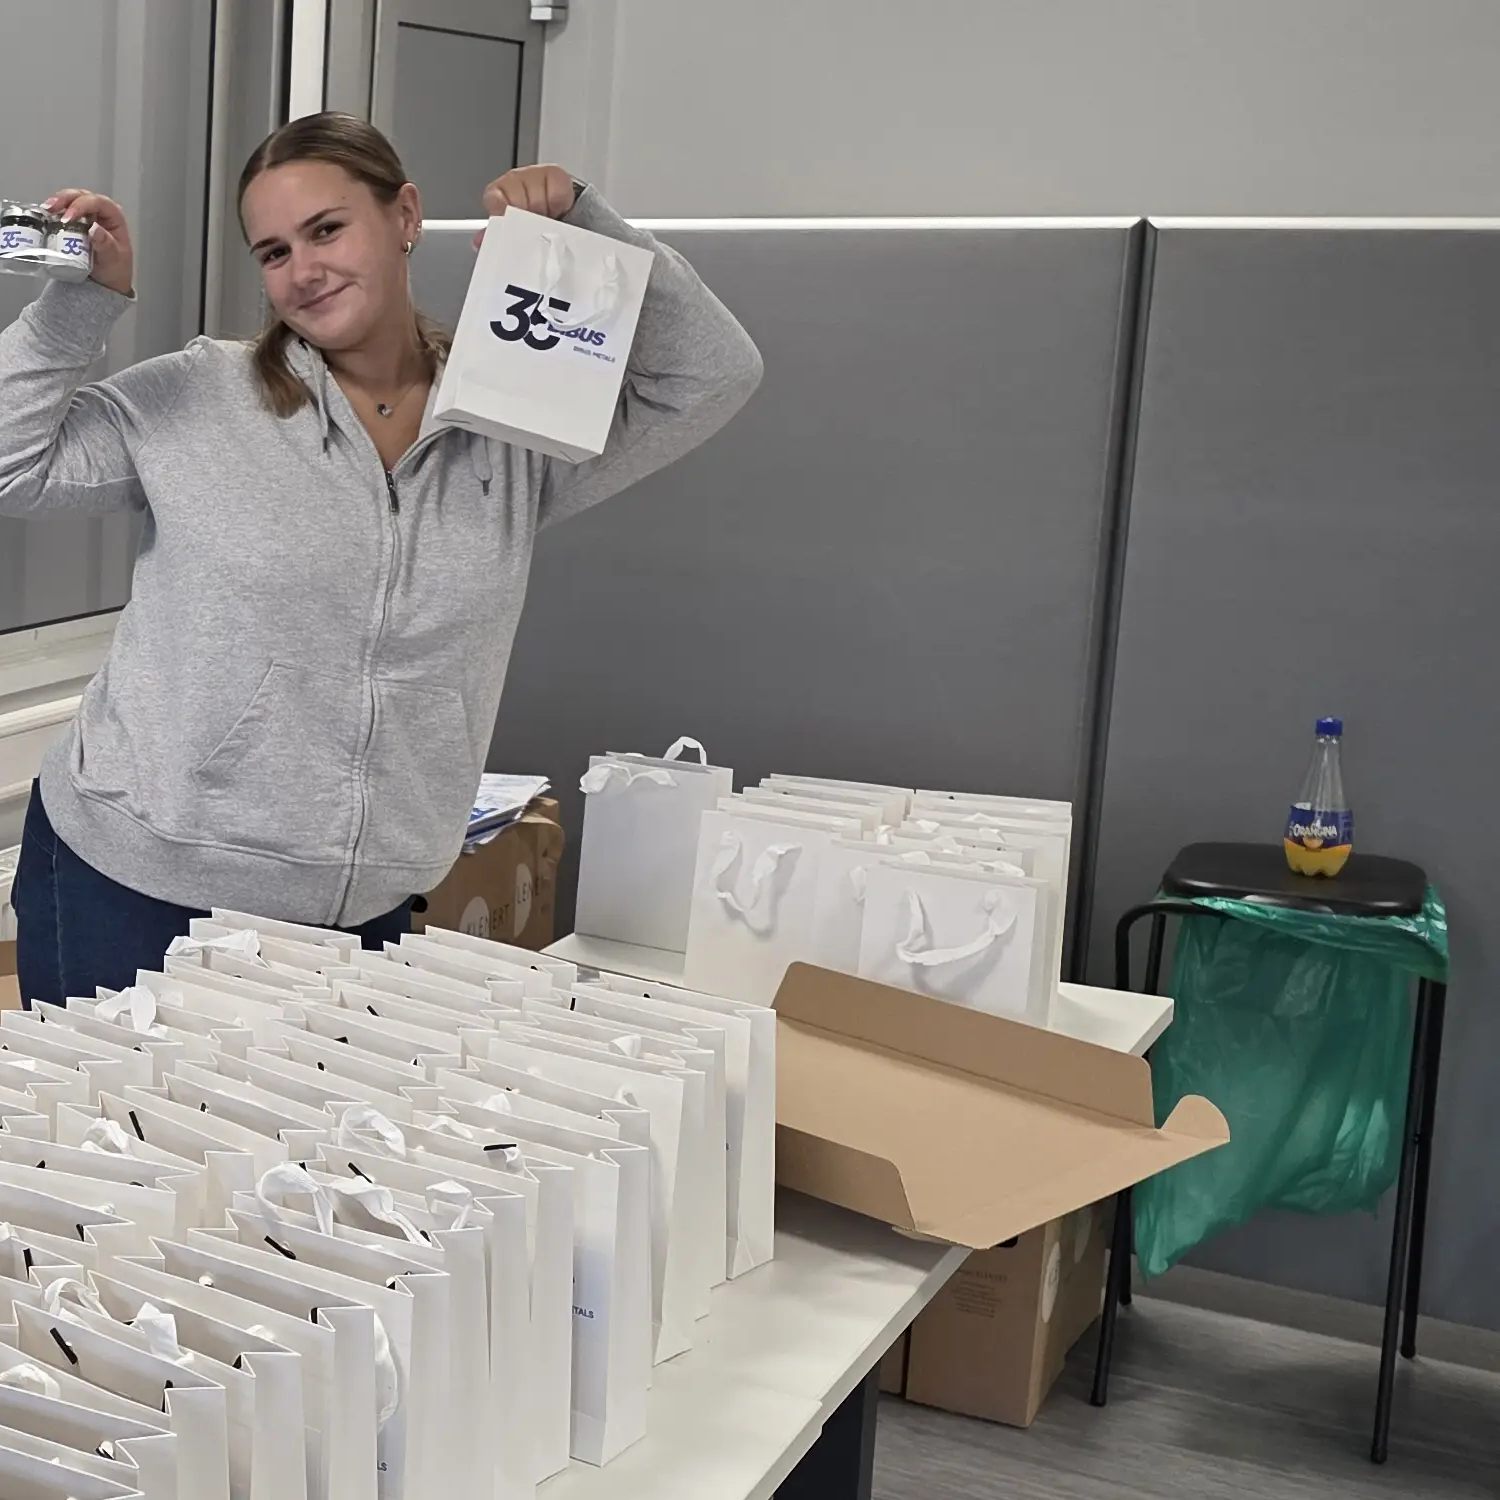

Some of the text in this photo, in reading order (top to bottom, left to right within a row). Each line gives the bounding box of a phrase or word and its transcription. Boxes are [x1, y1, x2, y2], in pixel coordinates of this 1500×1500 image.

[0, 231, 21, 249] 35
[61, 237, 83, 255] 35
[490, 284, 571, 351] 35
